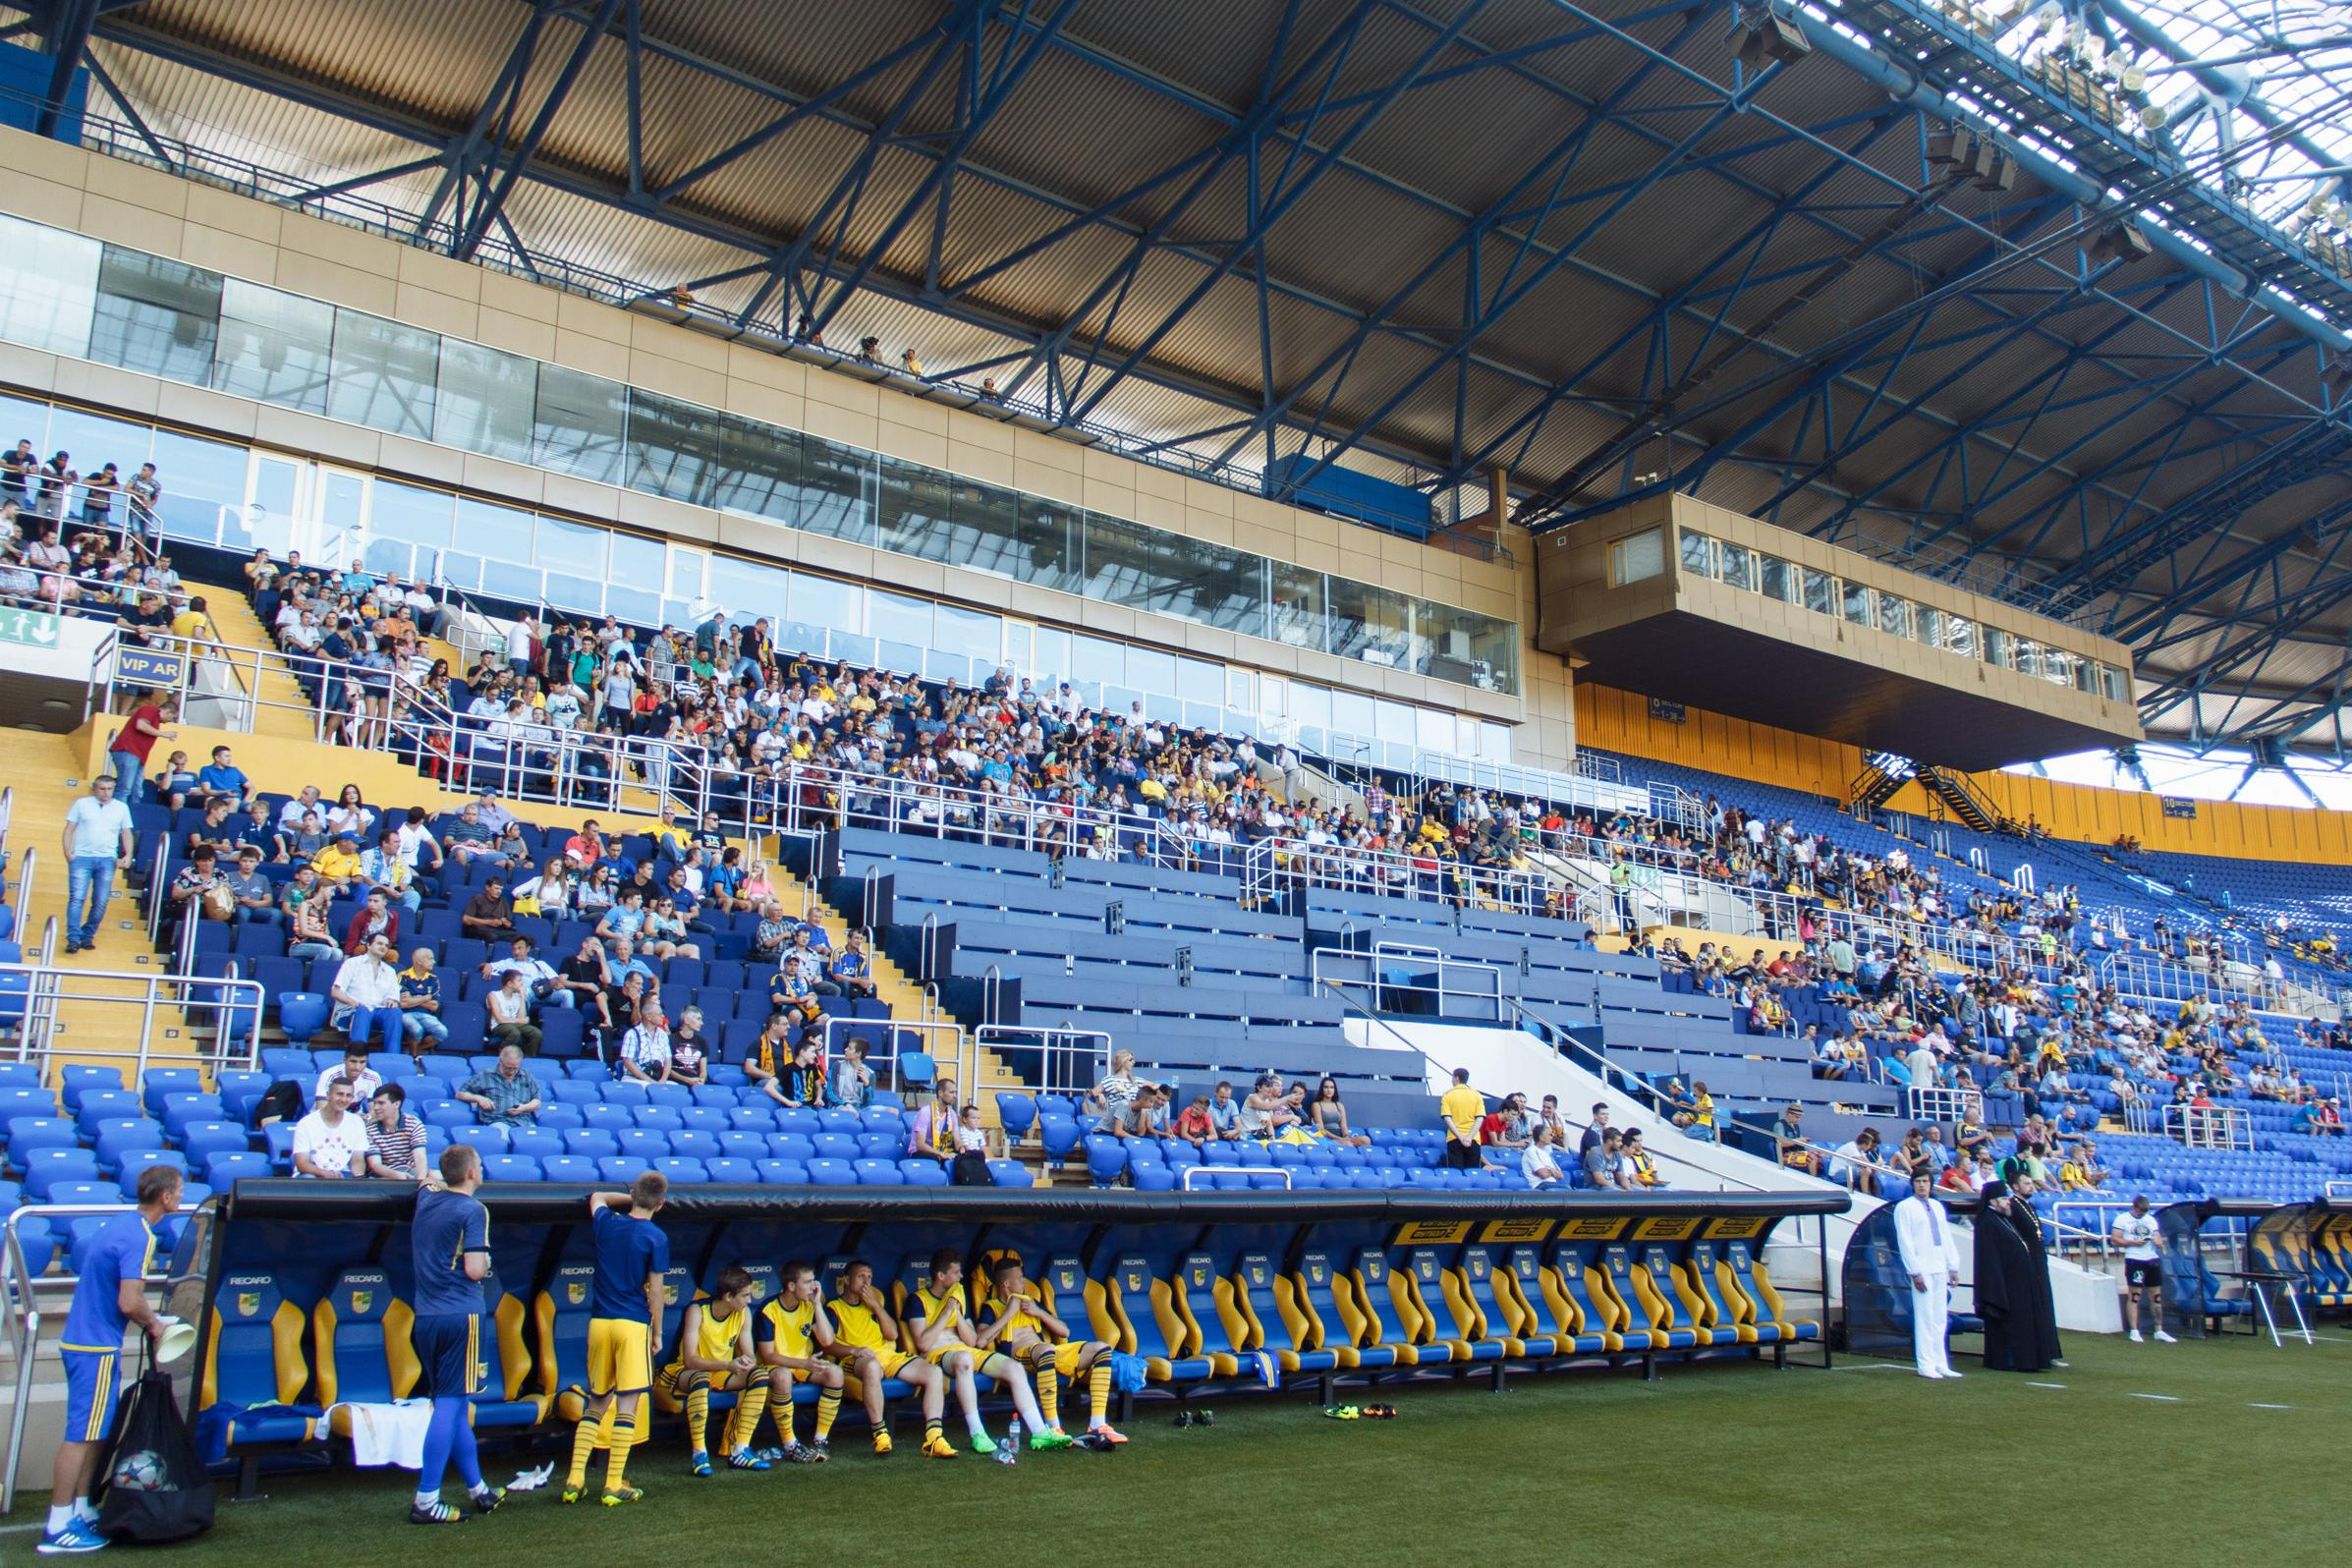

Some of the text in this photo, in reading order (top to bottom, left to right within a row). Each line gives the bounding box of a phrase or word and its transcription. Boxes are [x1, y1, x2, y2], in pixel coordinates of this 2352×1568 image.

[122, 656, 177, 676] VIP AR
[230, 1276, 271, 1285] RECARO
